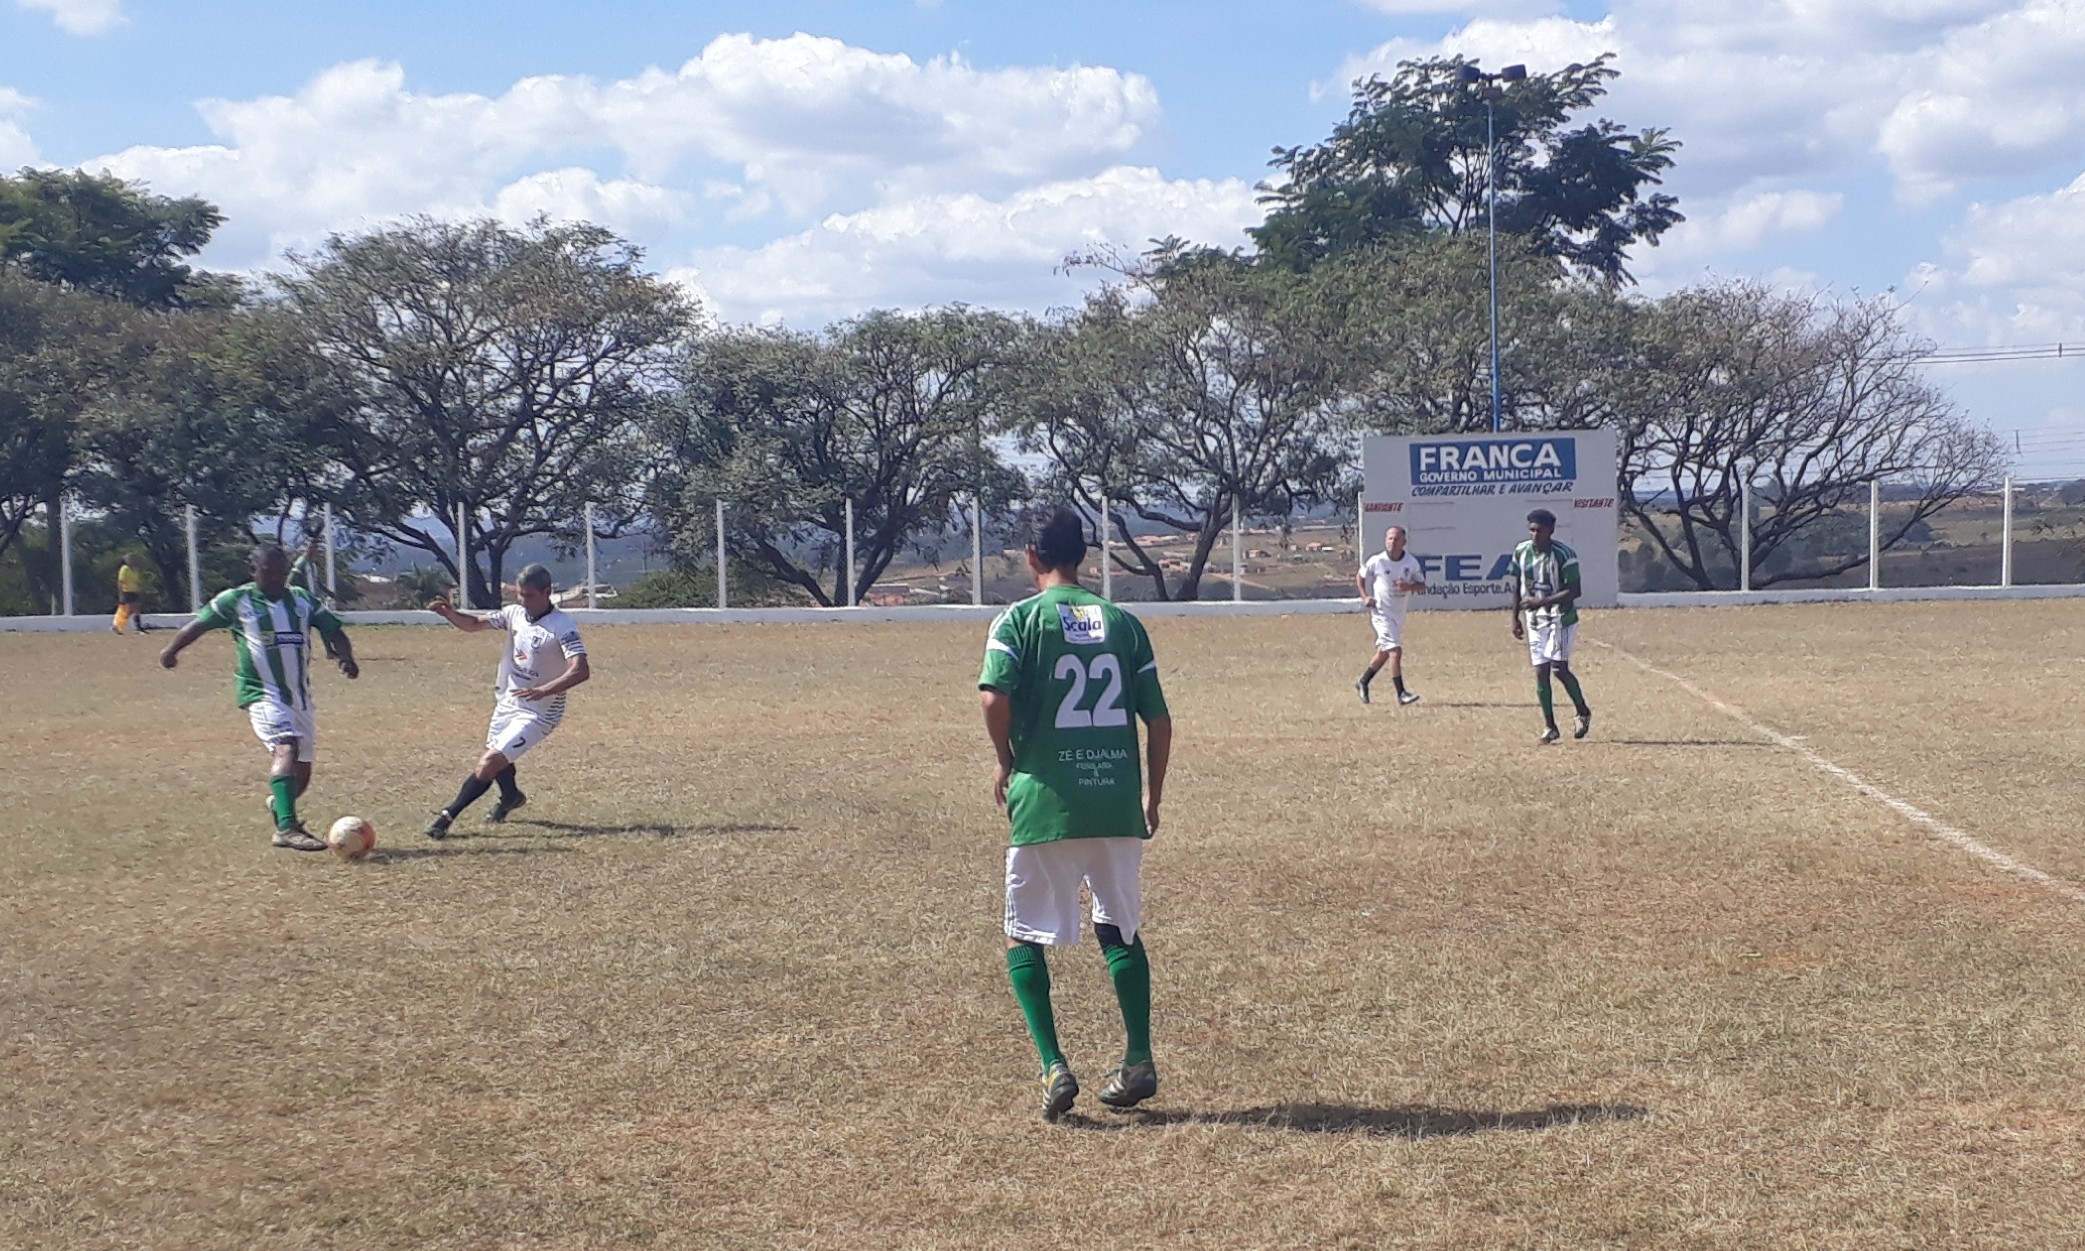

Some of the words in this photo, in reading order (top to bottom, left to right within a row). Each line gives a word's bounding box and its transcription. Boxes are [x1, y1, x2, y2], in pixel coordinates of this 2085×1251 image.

[1419, 442, 1562, 471] FRANCA
[1419, 470, 1478, 483] GOVERNO
[1484, 467, 1562, 481] MUNICIPAL
[1411, 484, 1496, 497] COMPARTILHAR
[1499, 484, 1507, 495] E
[1508, 481, 1574, 495] AVANÇAR
[1062, 616, 1102, 632] Scala
[1054, 653, 1128, 729] 22
[1076, 749, 1084, 760] E
[1086, 748, 1128, 760] DJALMA
[1078, 778, 1115, 786] PINTURA
